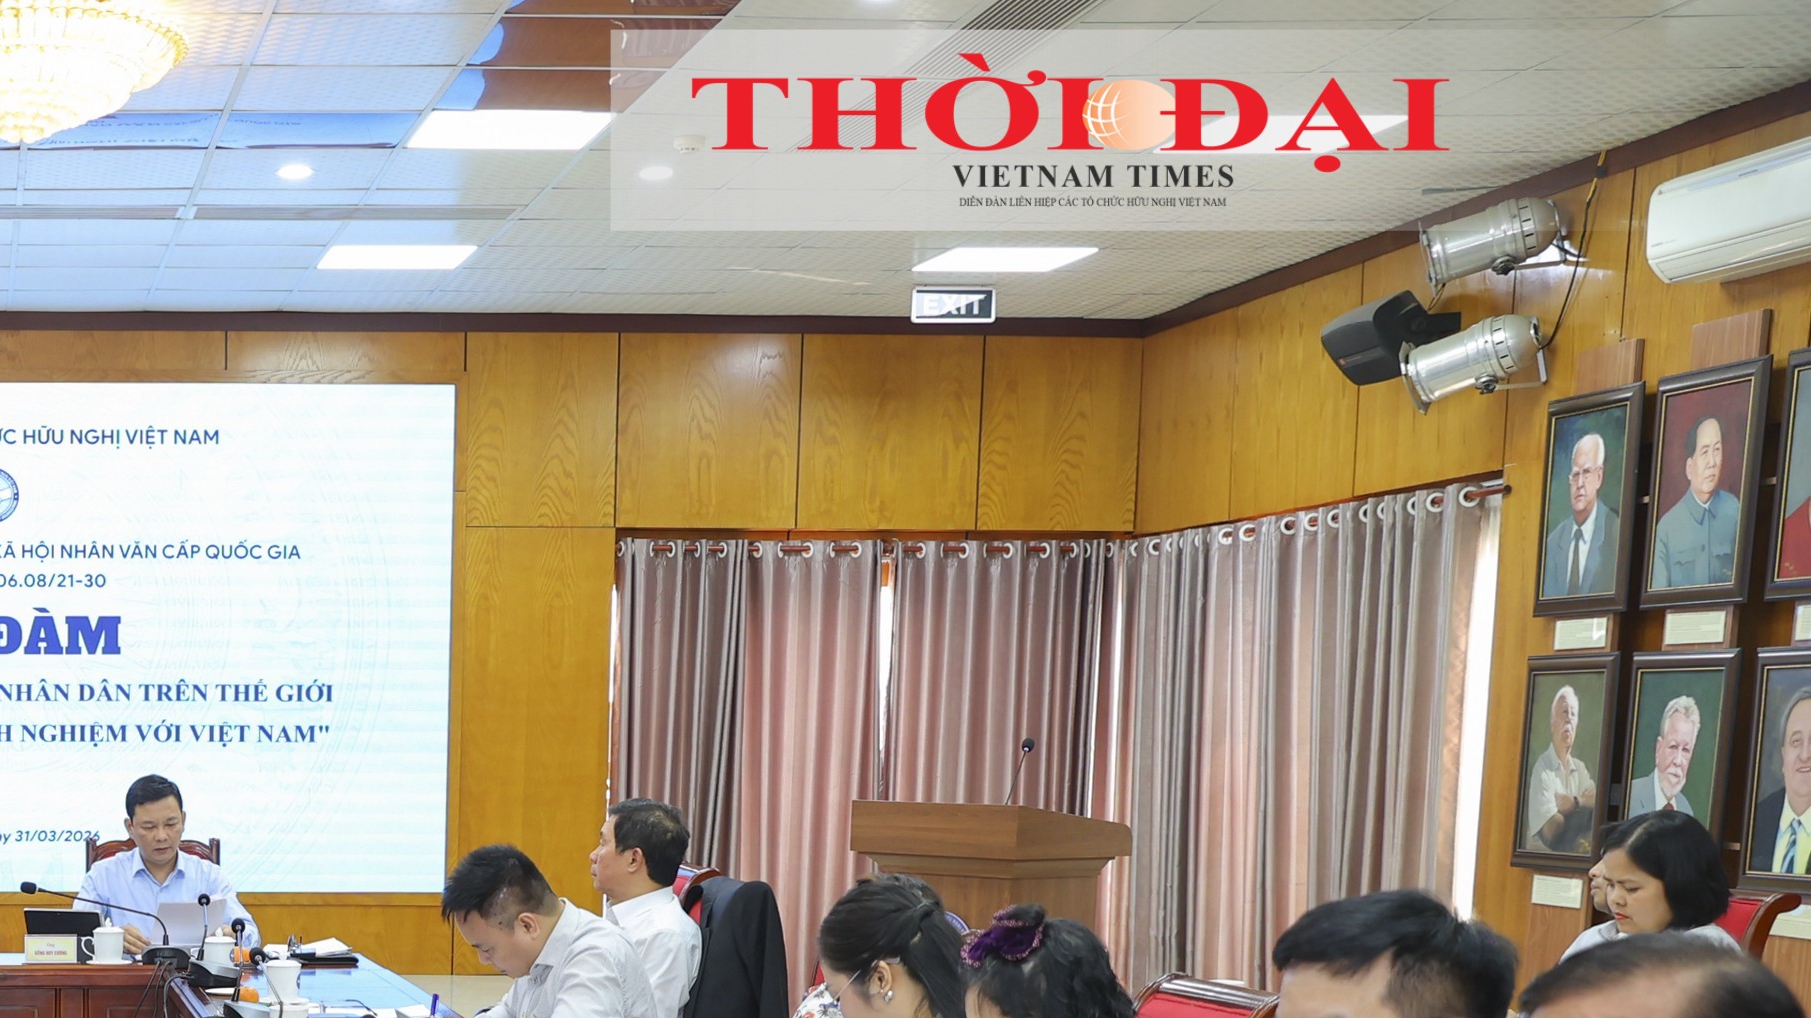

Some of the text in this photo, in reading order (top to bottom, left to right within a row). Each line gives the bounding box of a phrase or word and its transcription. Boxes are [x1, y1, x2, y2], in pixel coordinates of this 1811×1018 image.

[923, 293, 986, 315] EXIT
[23, 425, 64, 445] HỮU
[70, 429, 120, 449] NGHỊ
[125, 425, 168, 449] VIỆT
[174, 429, 219, 445] NAM
[21, 540, 55, 563] HỘI
[60, 540, 114, 559] NHÂN
[119, 541, 157, 559] VĂN
[162, 539, 201, 559] CẤP
[205, 539, 262, 560] QUỐC
[267, 544, 301, 560] GIA
[79, 679, 131, 702] DÂN
[138, 679, 208, 702] TRÊN
[215, 679, 268, 702] THẾ
[275, 679, 333, 703] GIỚI
[21, 721, 127, 748] NGHIỆM
[135, 719, 181, 743] VỚI
[189, 721, 250, 748] VIỆT
[257, 724, 330, 743] NAM"
